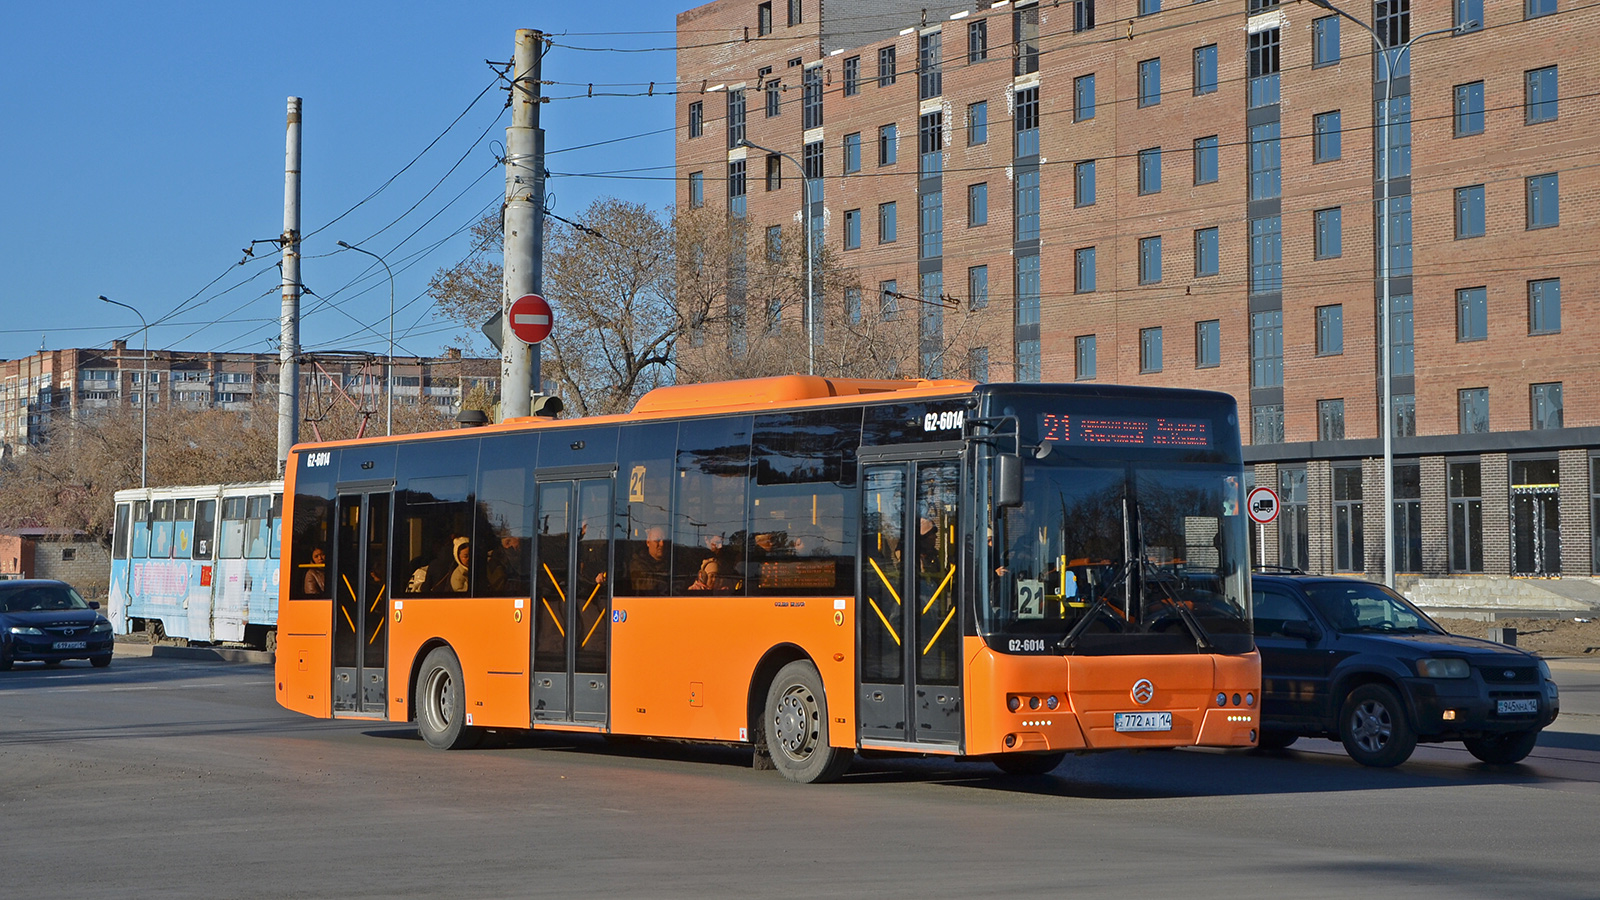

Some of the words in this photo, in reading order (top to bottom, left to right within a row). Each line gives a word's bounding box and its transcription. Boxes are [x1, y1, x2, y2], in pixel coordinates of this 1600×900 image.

[924, 410, 964, 432] G2-6014
[1044, 414, 1070, 441] 21
[631, 472, 645, 495] 21
[1019, 586, 1044, 615] 21
[1008, 639, 1045, 651] G2-6014
[1125, 714, 1143, 727] 772
[1160, 714, 1171, 727] 14
